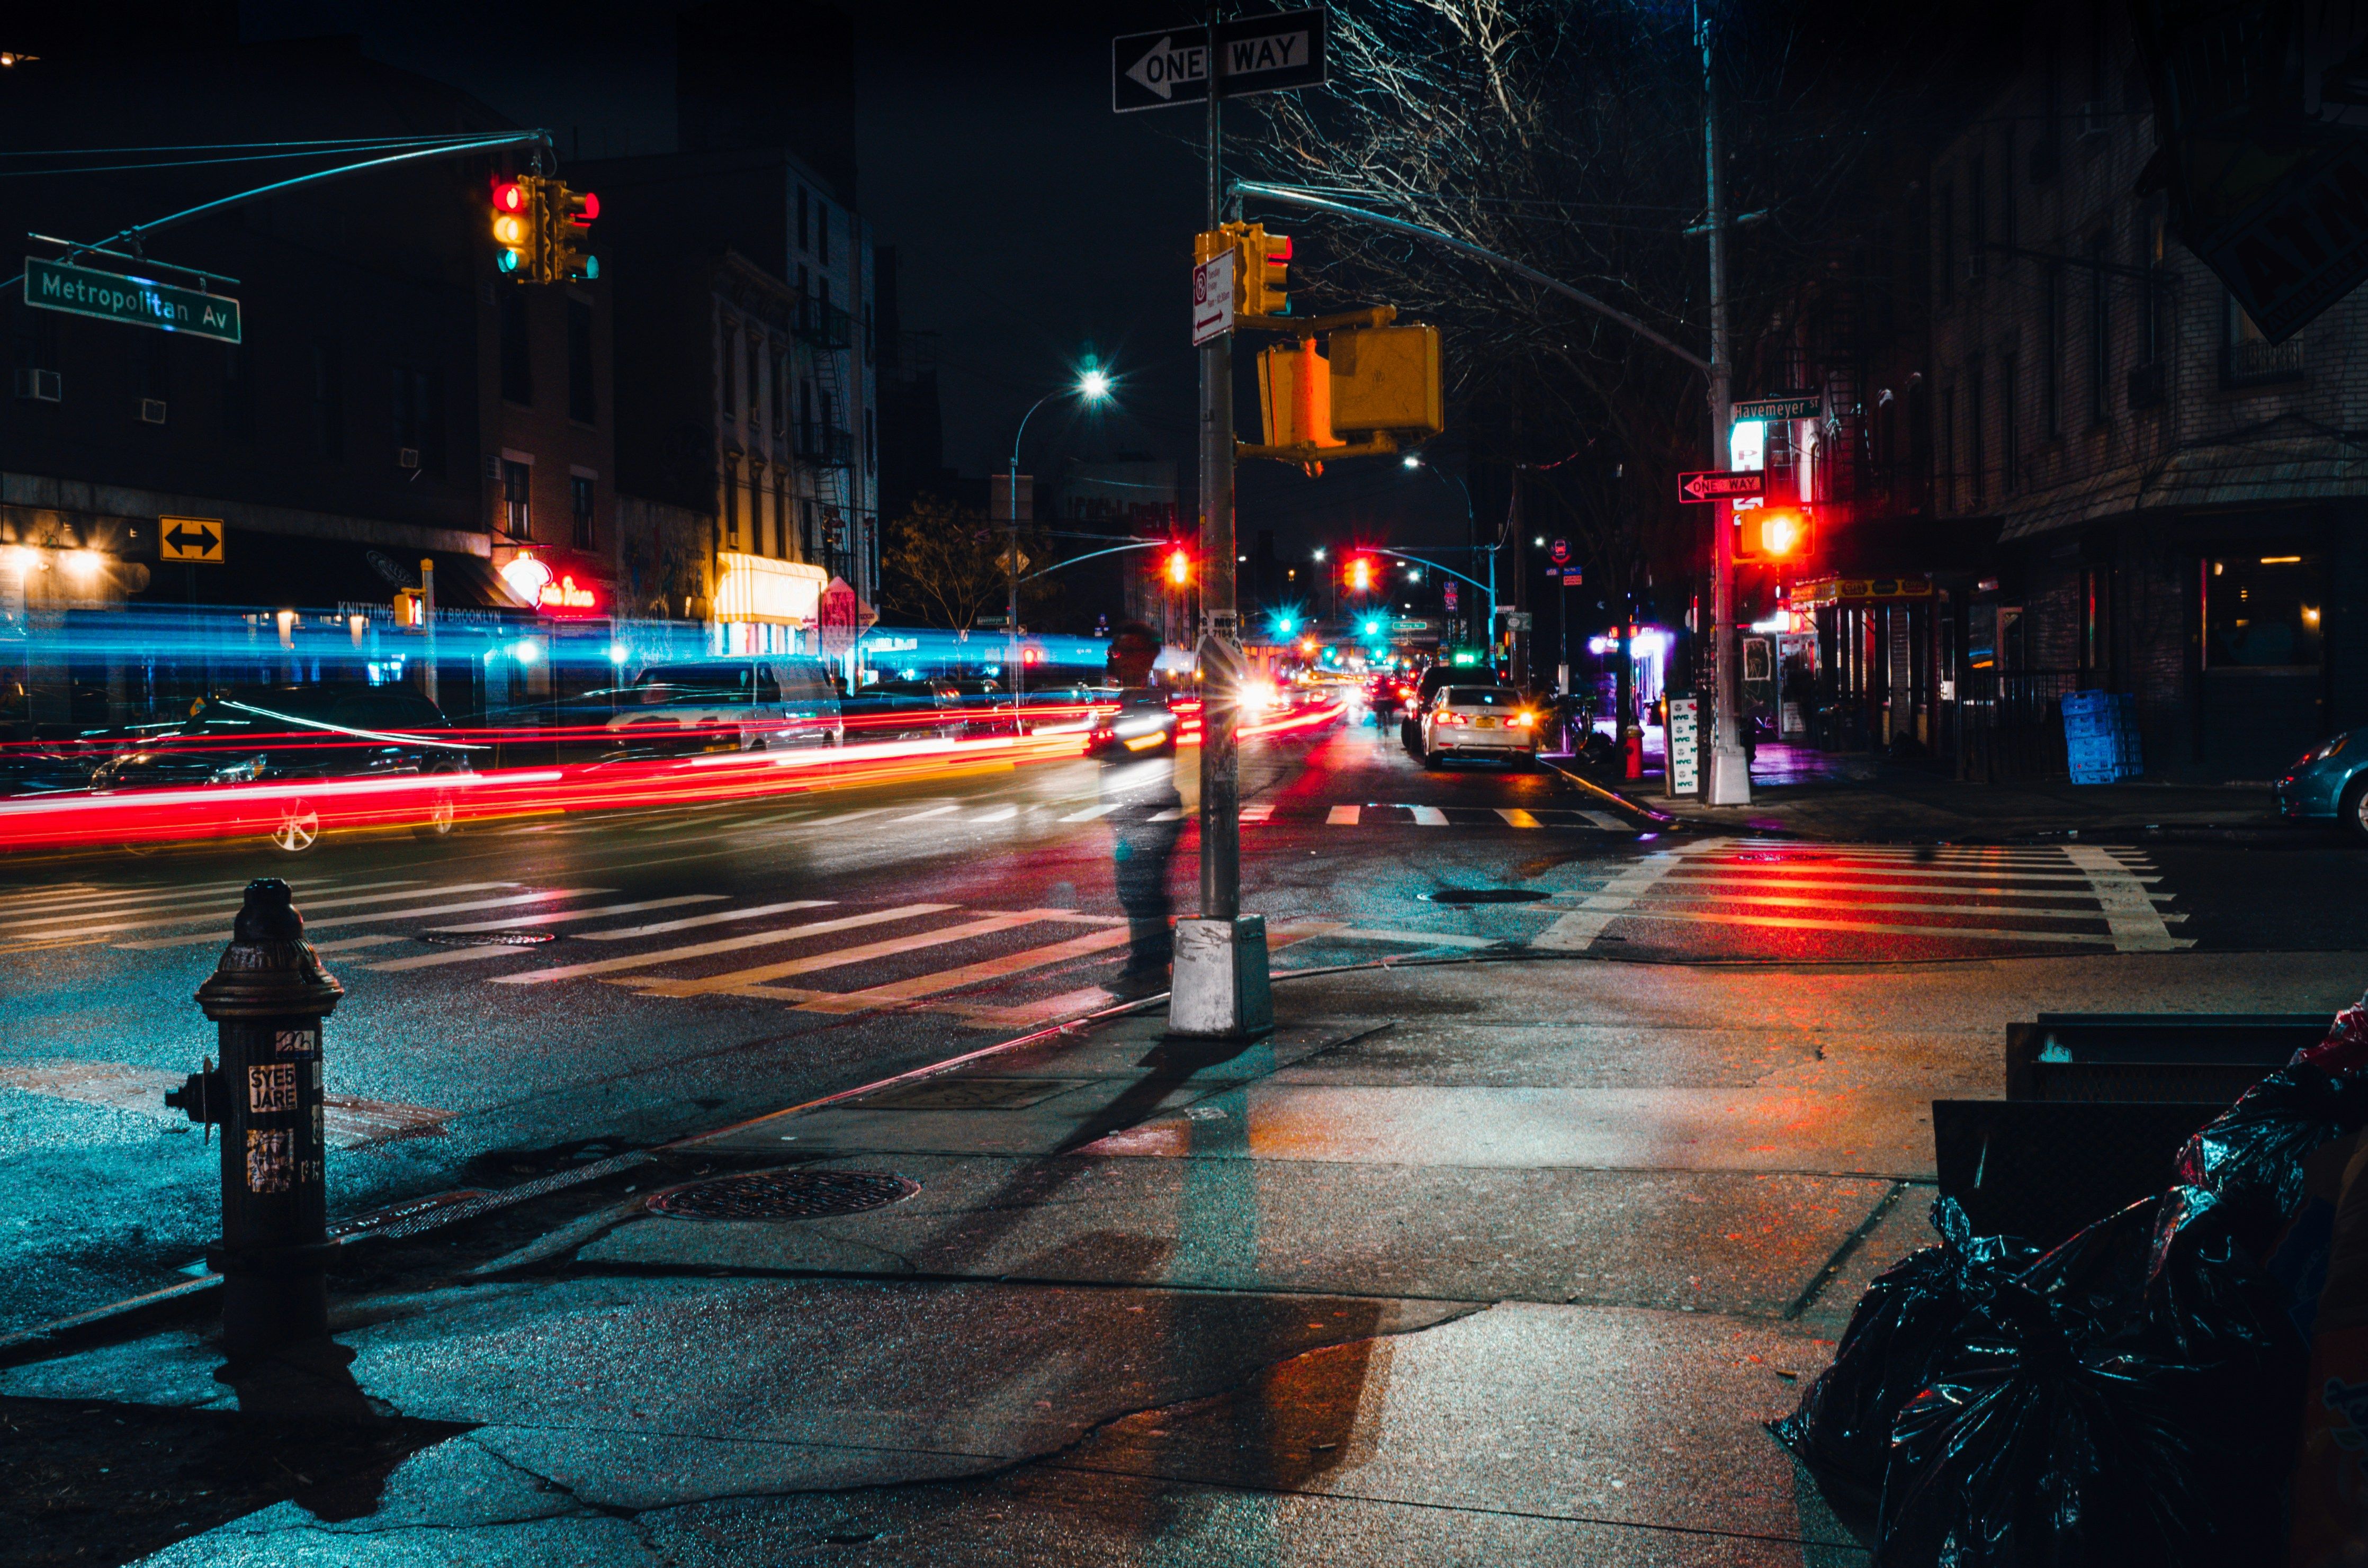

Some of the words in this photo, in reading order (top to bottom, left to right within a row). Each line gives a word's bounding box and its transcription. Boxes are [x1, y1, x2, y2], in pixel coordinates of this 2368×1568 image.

[1146, 50, 1203, 83] ONE
[1233, 35, 1296, 71] WAY
[42, 272, 188, 321] Metropolitan
[203, 305, 227, 329] Av
[1734, 403, 1805, 419] Havemeyer
[1809, 399, 1818, 409] St
[1693, 480, 1717, 493] ONE
[1729, 479, 1755, 491] WAY
[337, 600, 393, 619] KNITTING
[449, 608, 501, 624] BROOKLYN
[253, 1090, 295, 1109] JARE
